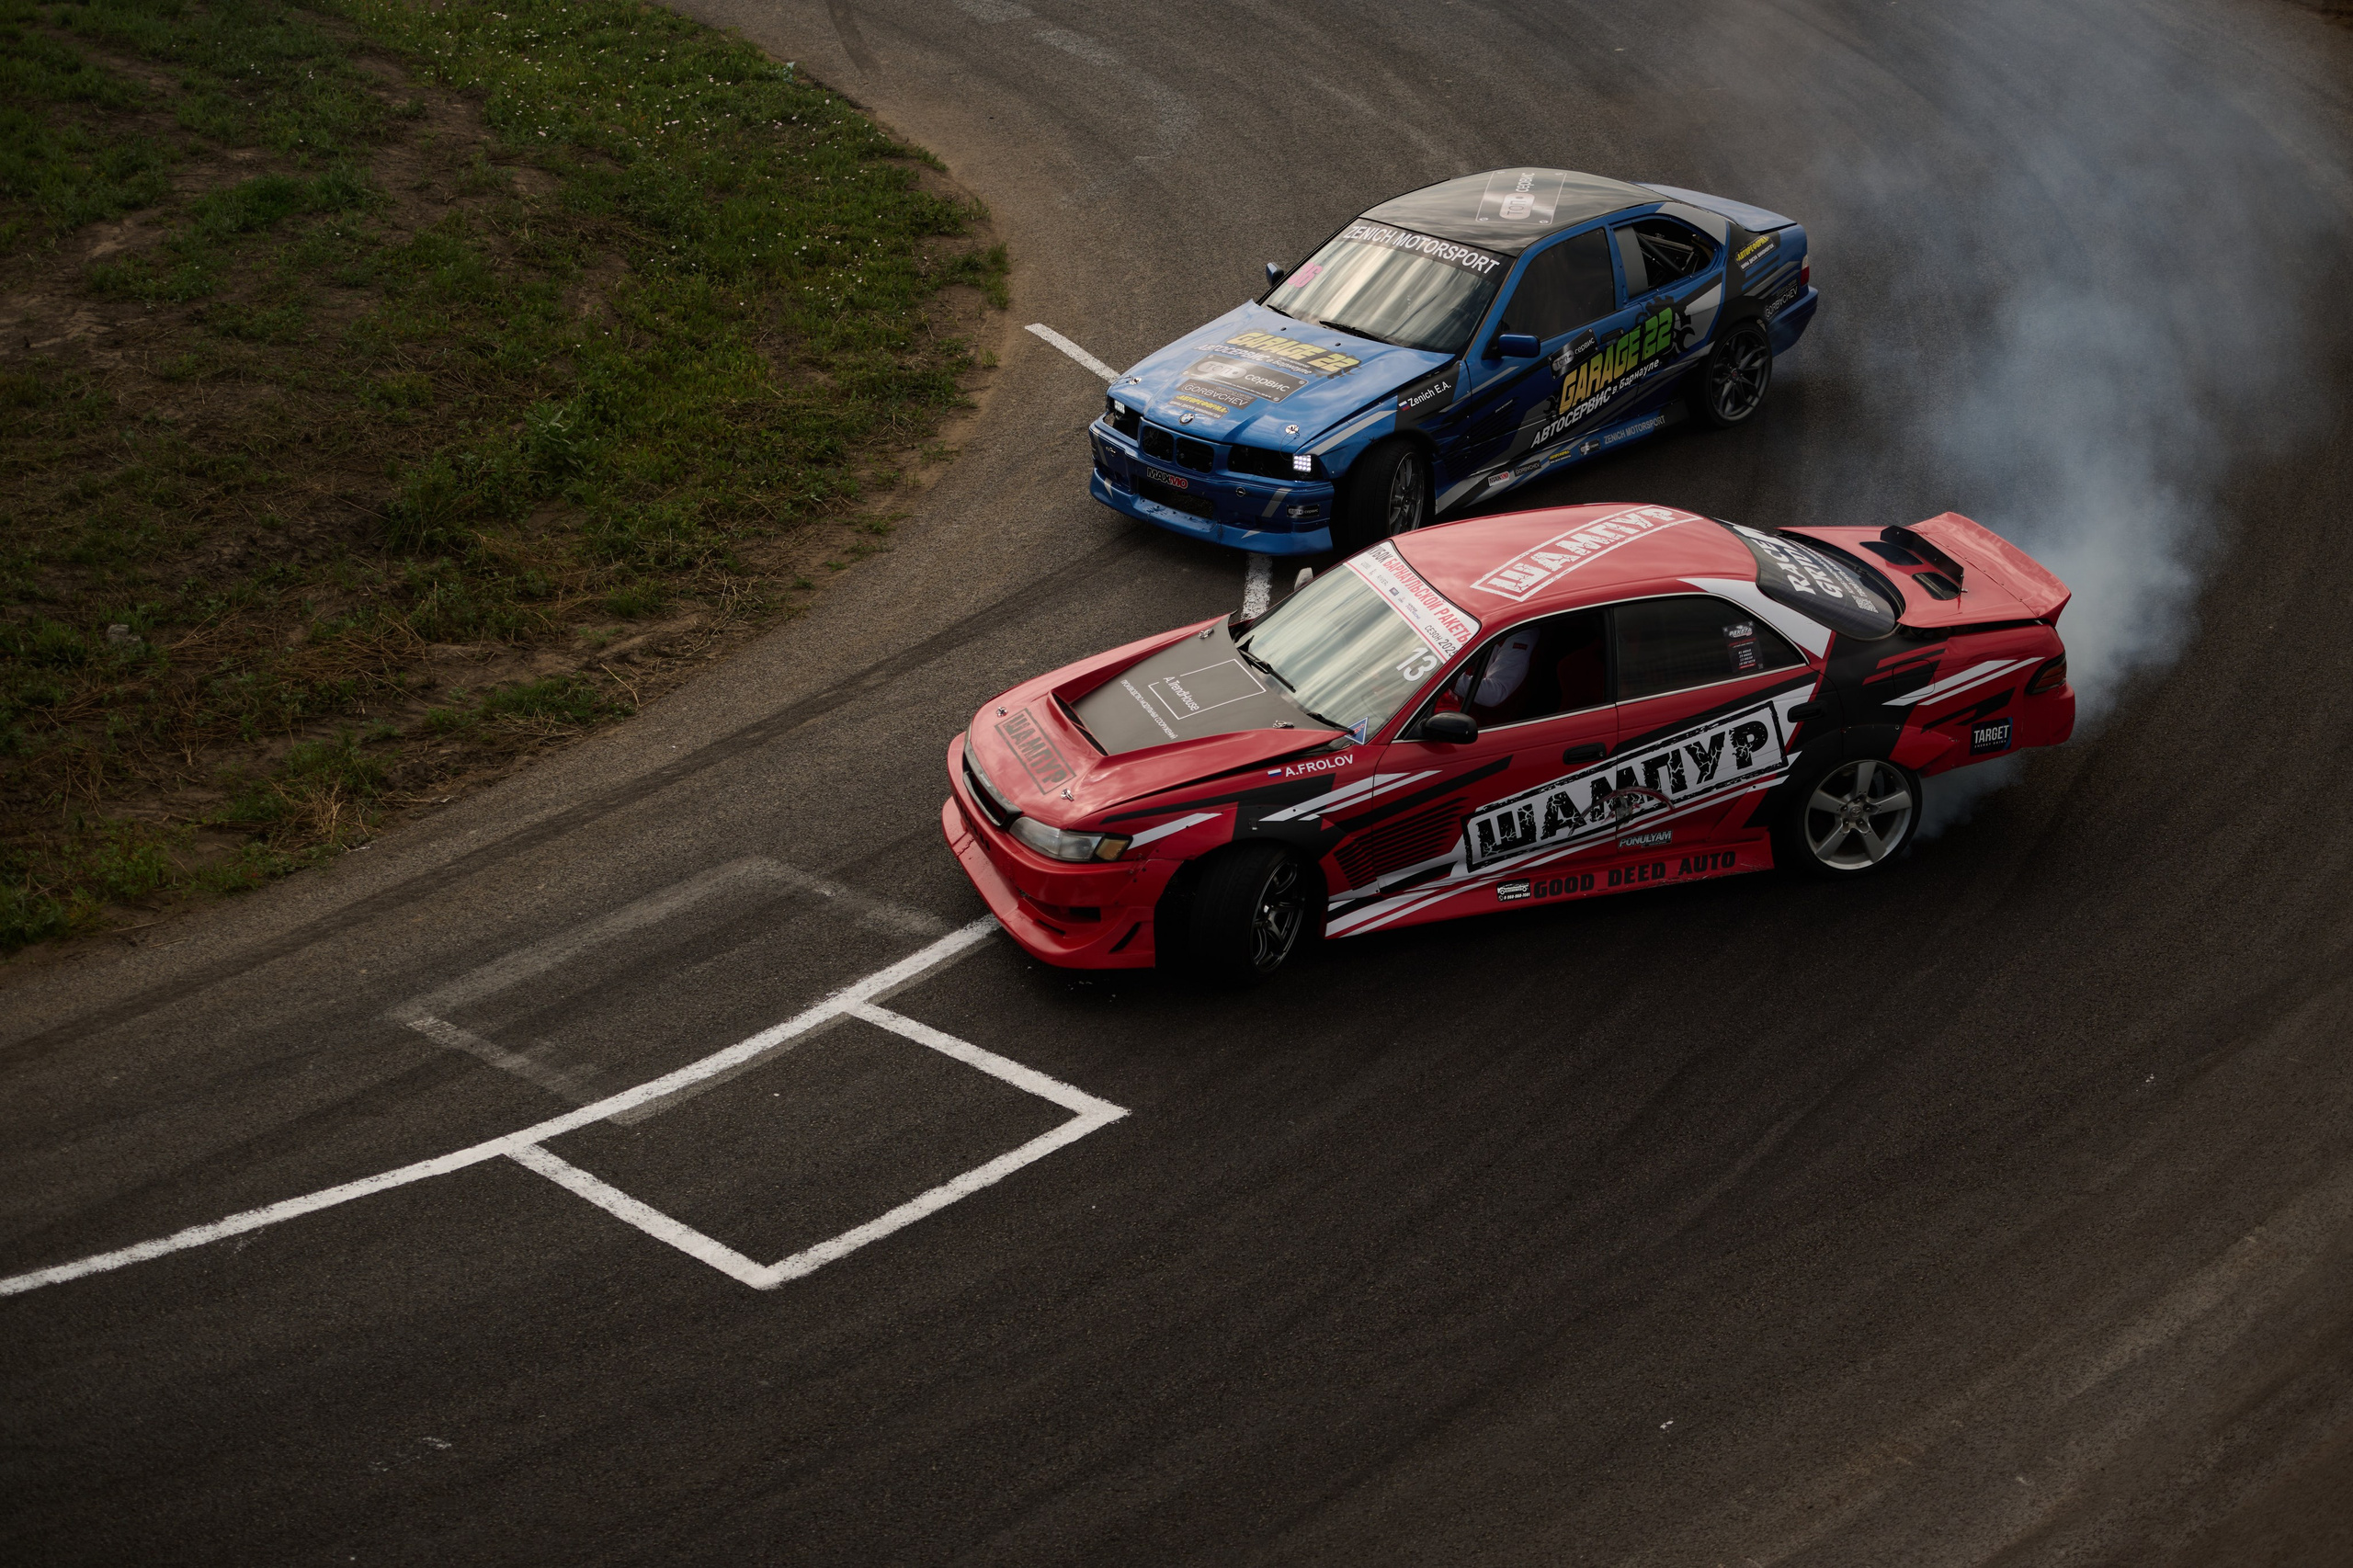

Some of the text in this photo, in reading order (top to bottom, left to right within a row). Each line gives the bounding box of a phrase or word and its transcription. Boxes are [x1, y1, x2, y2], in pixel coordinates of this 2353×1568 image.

[1342, 225, 1500, 274] ZENICH MOTORSPORT
[1194, 344, 1268, 363] АВТОСЕРВИС
[1225, 332, 1327, 360] GARAGE
[1307, 353, 1361, 372] 22
[1558, 306, 1674, 415] GARAGE 22
[1574, 337, 1596, 356] сервис
[1245, 372, 1290, 392] сервис
[1407, 381, 1452, 407] Zenich E.A.
[1530, 387, 1612, 449] АВТОСЕРВИС
[1611, 385, 1619, 395] в
[1619, 358, 1660, 390] Барнауле
[1604, 415, 1665, 445] ZENICH MOTORSPORT
[1146, 466, 1189, 490] MAXMO
[1486, 508, 1676, 593] ШАМПУР
[1749, 538, 1816, 595] RACE
[1382, 558, 1447, 611] БАРНАУЛЬСКОЙ
[1783, 547, 1844, 597] GRID
[1425, 624, 1442, 642] СЕЗОН
[1395, 646, 1438, 682] 13
[1003, 713, 1066, 784] ШАМПУР
[1973, 724, 2009, 744] TARGET
[1285, 754, 1353, 778] A.FROLOV
[1477, 721, 1768, 858] ШАМПУР
[1619, 830, 1672, 847] PONULYAM
